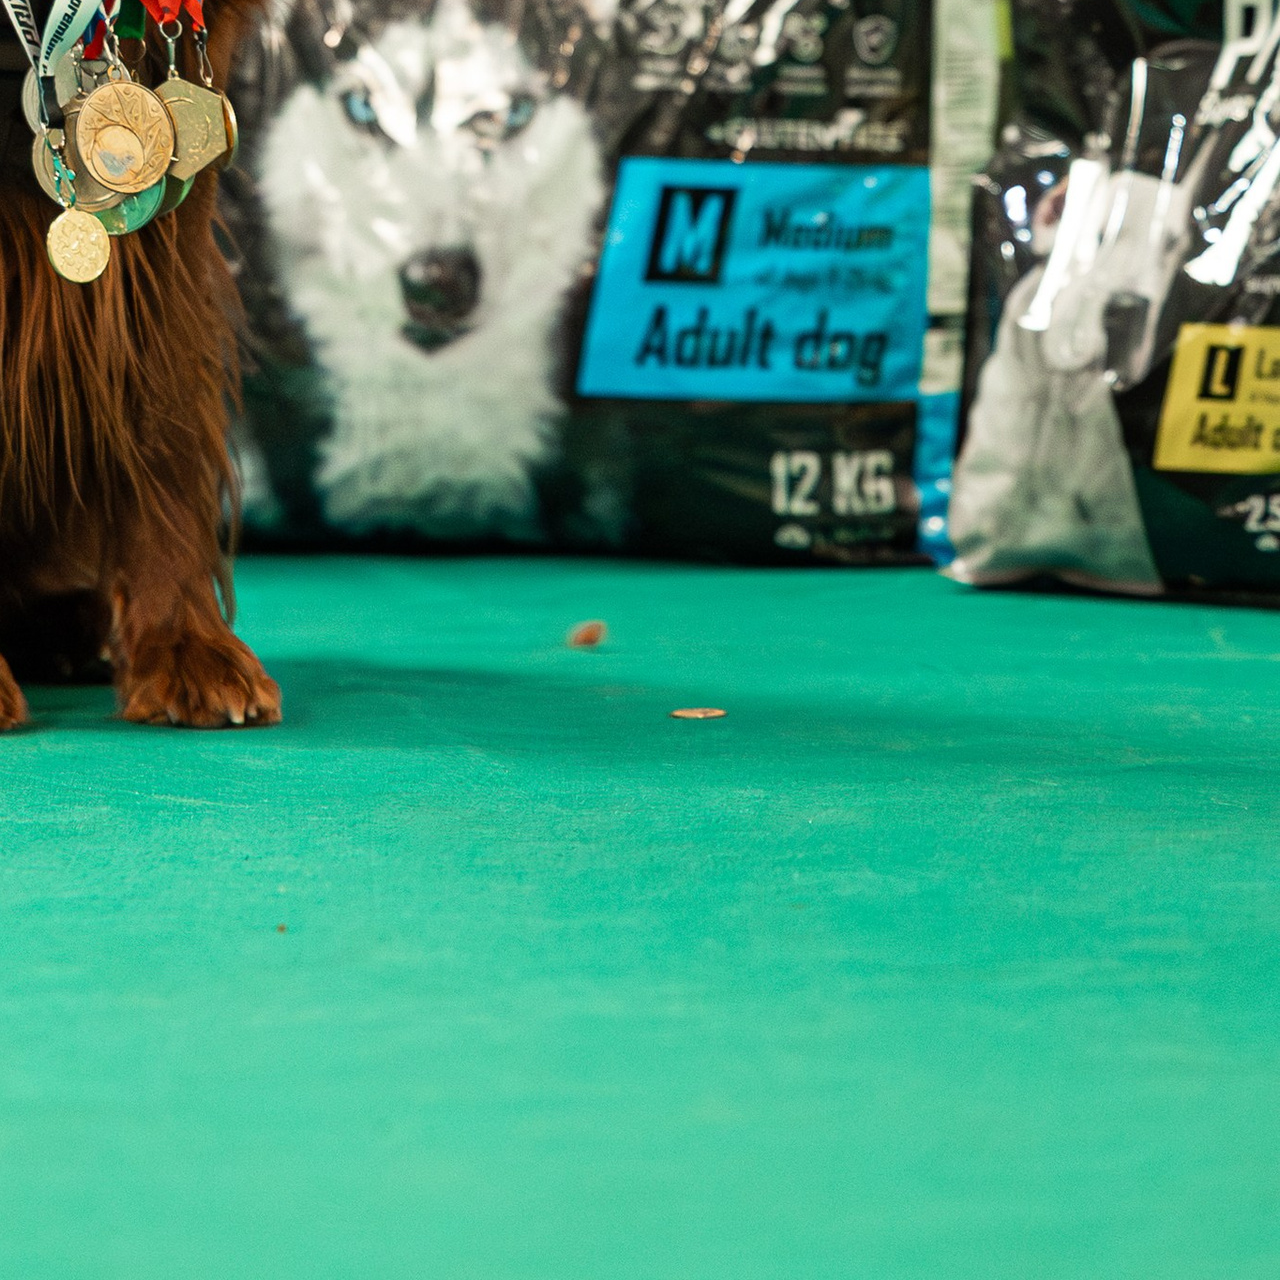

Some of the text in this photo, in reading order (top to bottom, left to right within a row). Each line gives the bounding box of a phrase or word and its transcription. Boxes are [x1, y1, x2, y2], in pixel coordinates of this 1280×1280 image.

[634, 305, 889, 388] Adult dog
[770, 449, 897, 517] 12 KG
